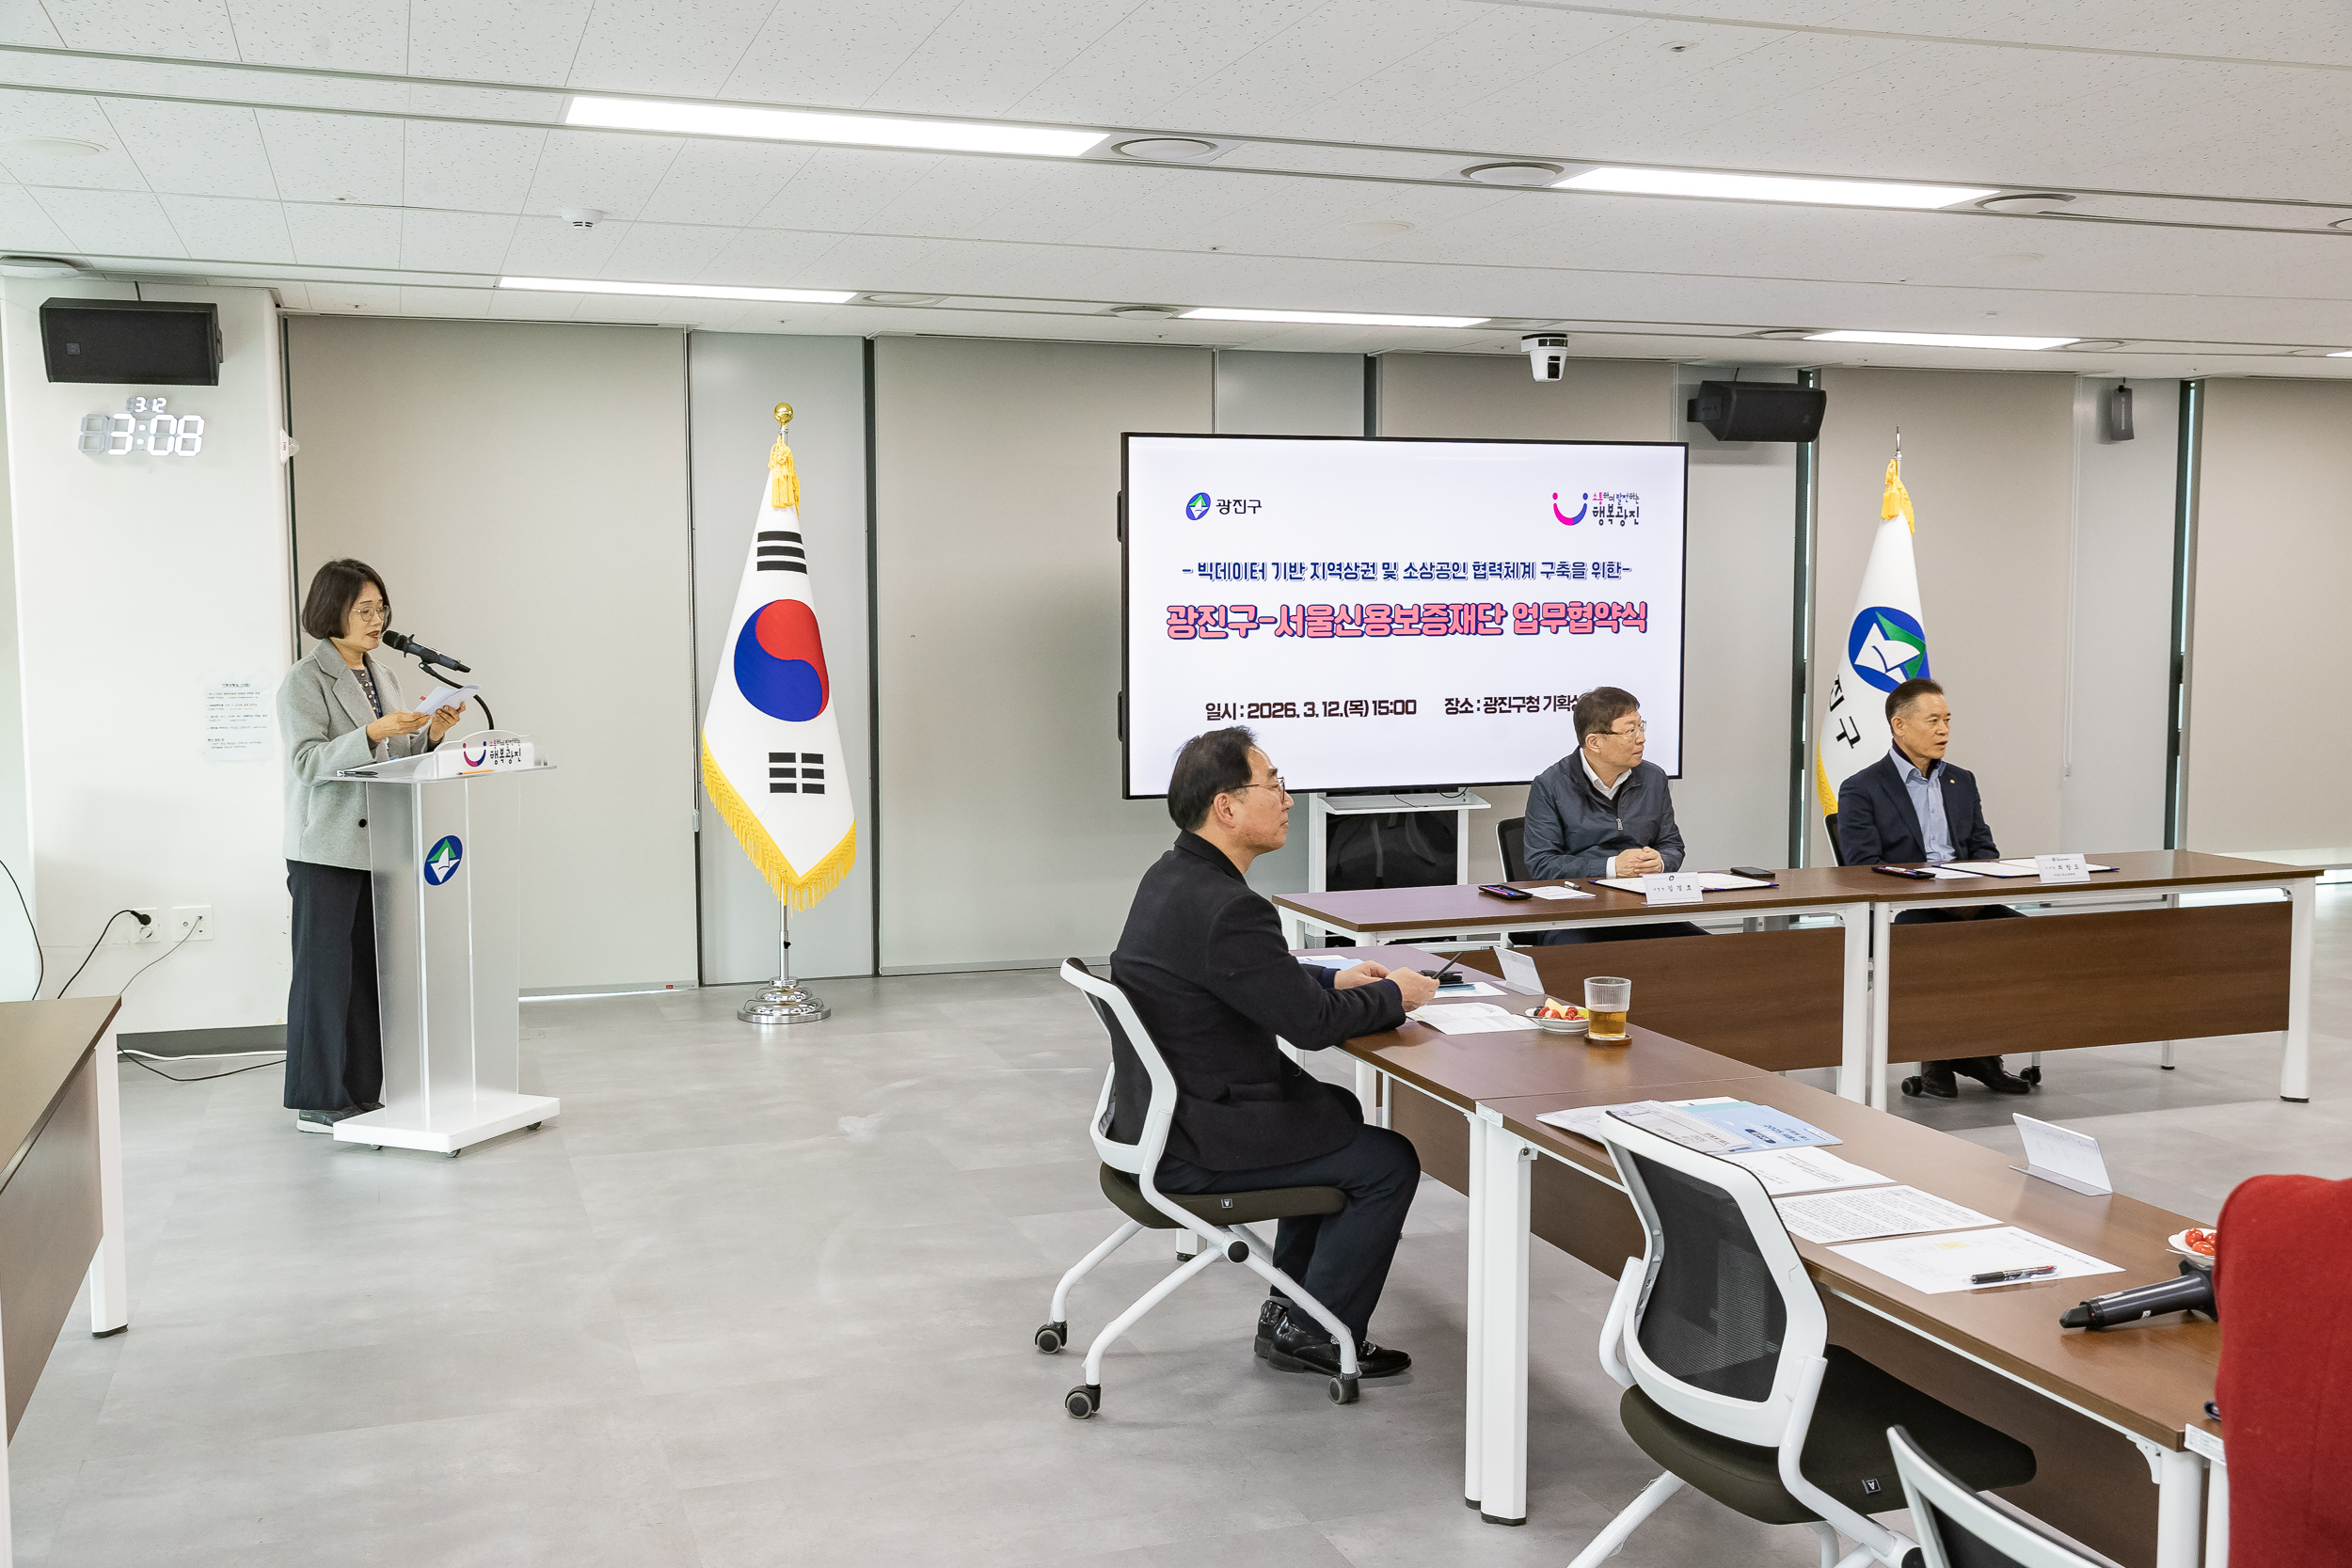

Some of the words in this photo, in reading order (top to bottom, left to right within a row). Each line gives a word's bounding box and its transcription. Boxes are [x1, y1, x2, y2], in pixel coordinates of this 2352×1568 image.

[107, 413, 205, 457] 3:08
[1216, 499, 1263, 515] 광진구
[1592, 504, 1640, 527] 행복광진
[1198, 562, 1267, 581] 빅데이터
[1271, 562, 1307, 581] 기반
[1310, 562, 1377, 581] 지역상권
[1382, 562, 1399, 581] 및
[1403, 562, 1468, 581] 소상공인
[1472, 562, 1536, 580] 협력체계
[1540, 562, 1587, 580] 구축을
[1166, 602, 1509, 641] 광진구-서울신용보증재단
[1513, 601, 1648, 636] 업무협약식
[1248, 702, 1300, 719] 2026.
[1303, 702, 1319, 718] 3.
[1372, 699, 1417, 716] 15:00
[1484, 695, 1540, 714] 광진구청
[489, 748, 521, 765] 행복광진
